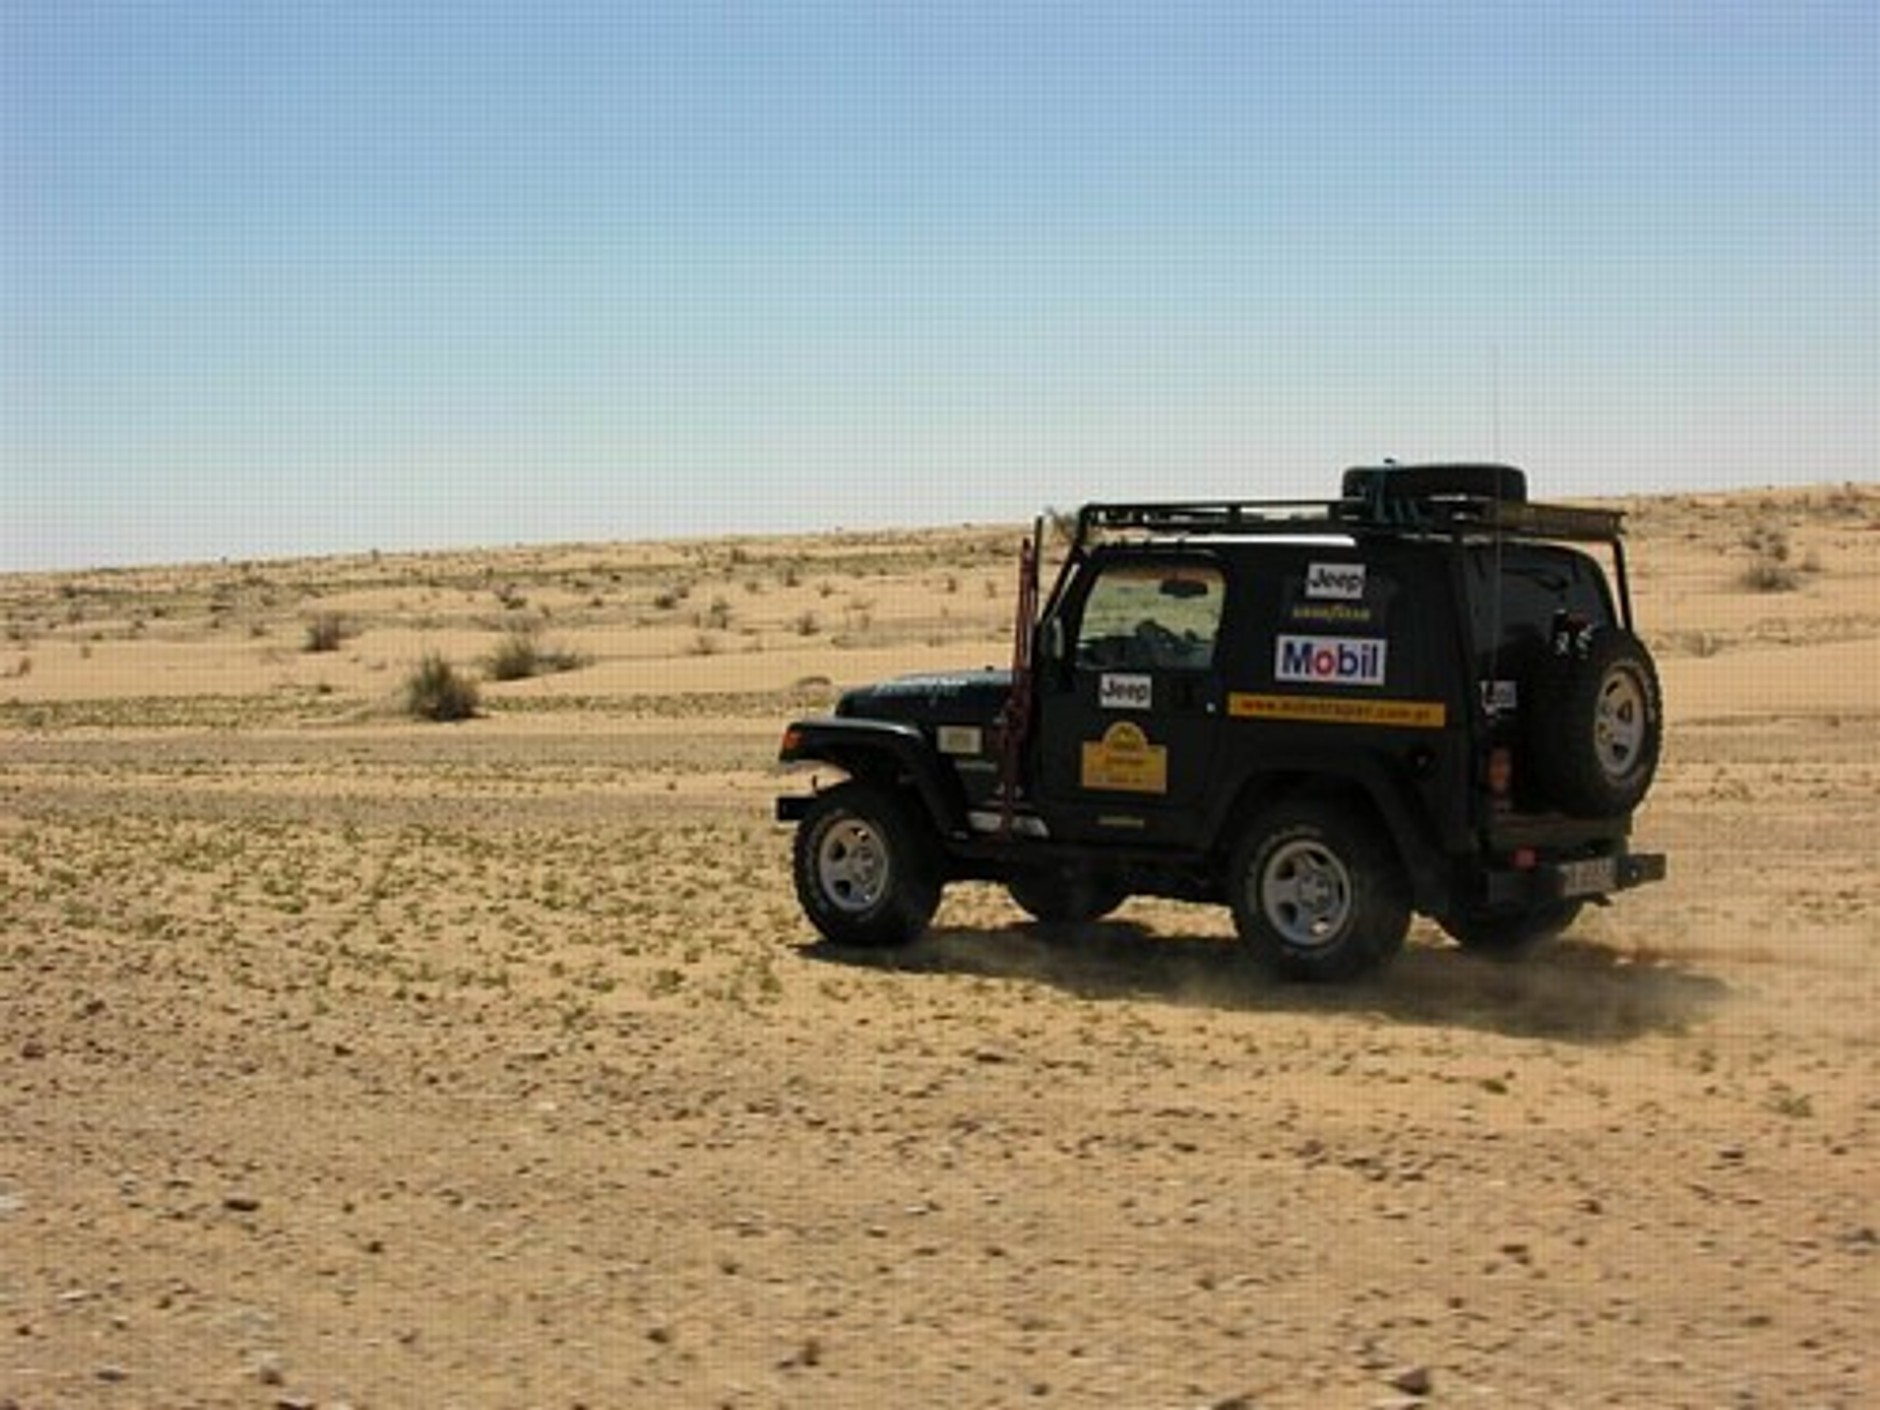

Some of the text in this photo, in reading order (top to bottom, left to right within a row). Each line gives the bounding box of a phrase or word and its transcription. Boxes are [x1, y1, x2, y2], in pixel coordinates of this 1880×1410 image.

[1310, 567, 1361, 593] Jeep
[1282, 641, 1379, 678] Mobil
[1101, 678, 1148, 703] Jeep
